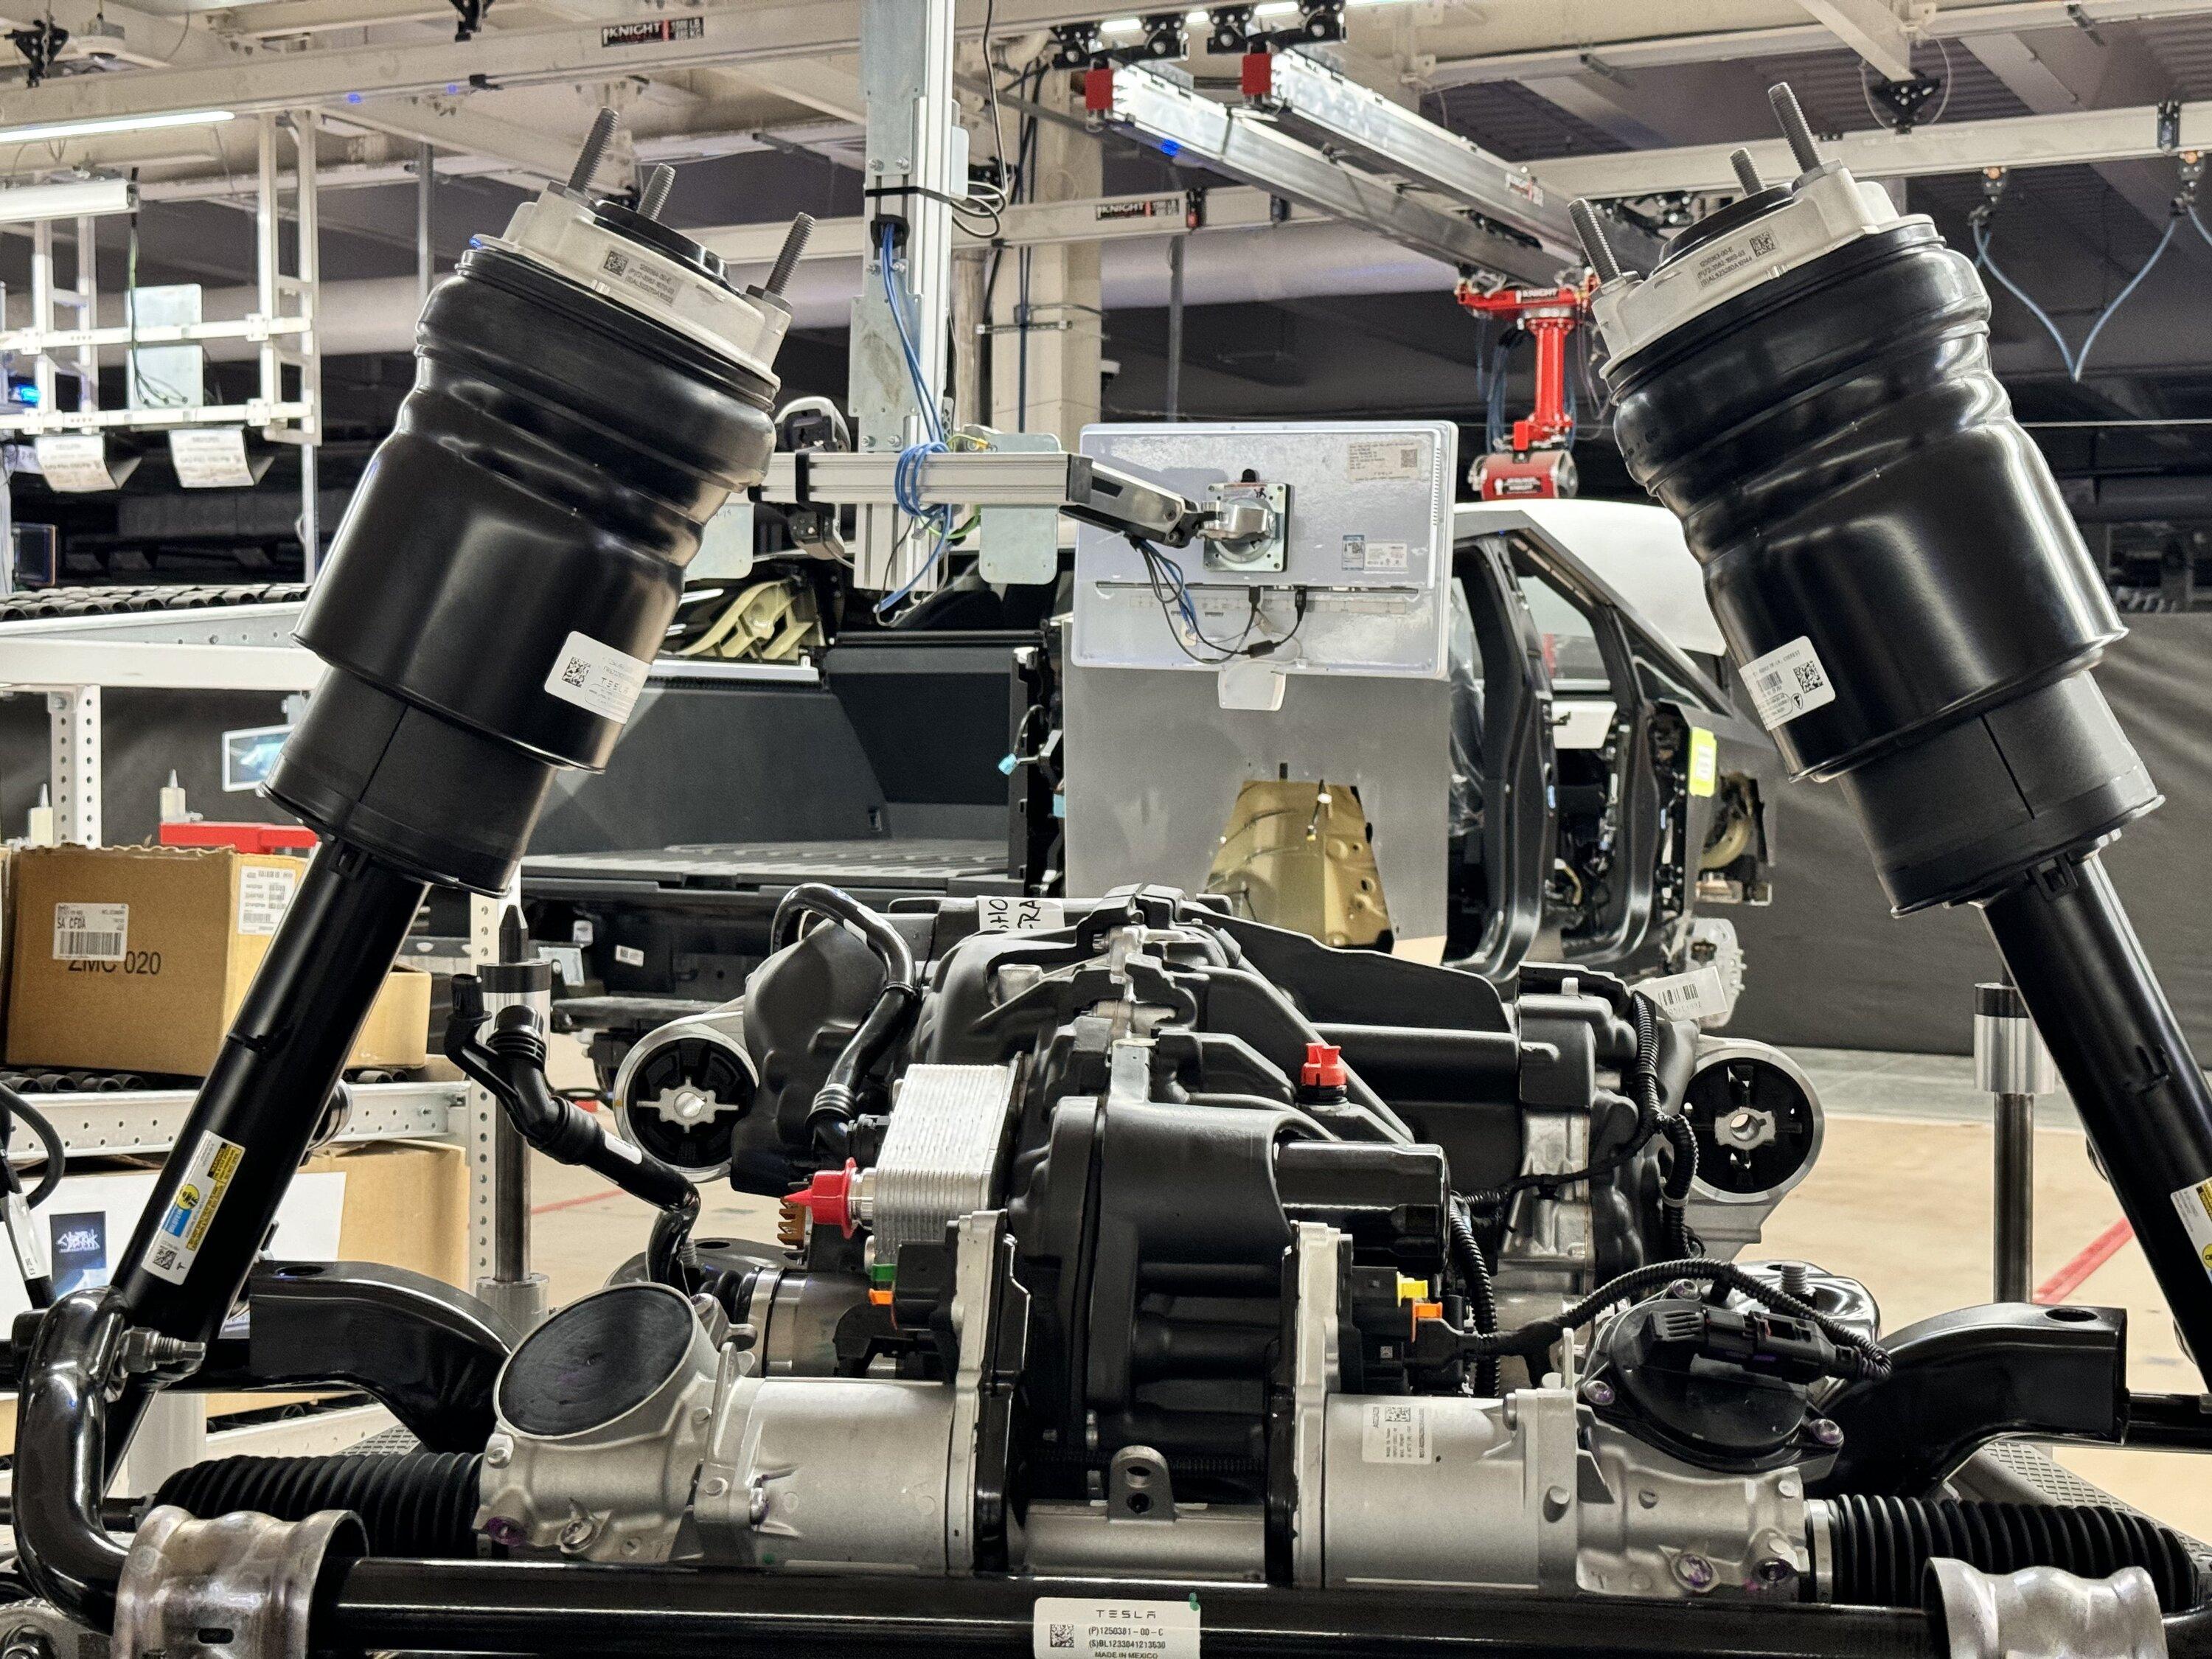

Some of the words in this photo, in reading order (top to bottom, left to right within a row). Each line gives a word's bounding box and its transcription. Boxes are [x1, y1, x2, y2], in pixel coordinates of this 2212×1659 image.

[609, 22, 661, 38] KNIGHT
[987, 899, 1009, 929] HO
[124, 950, 161, 975] 020
[1096, 1610, 1156, 1618] TESLA
